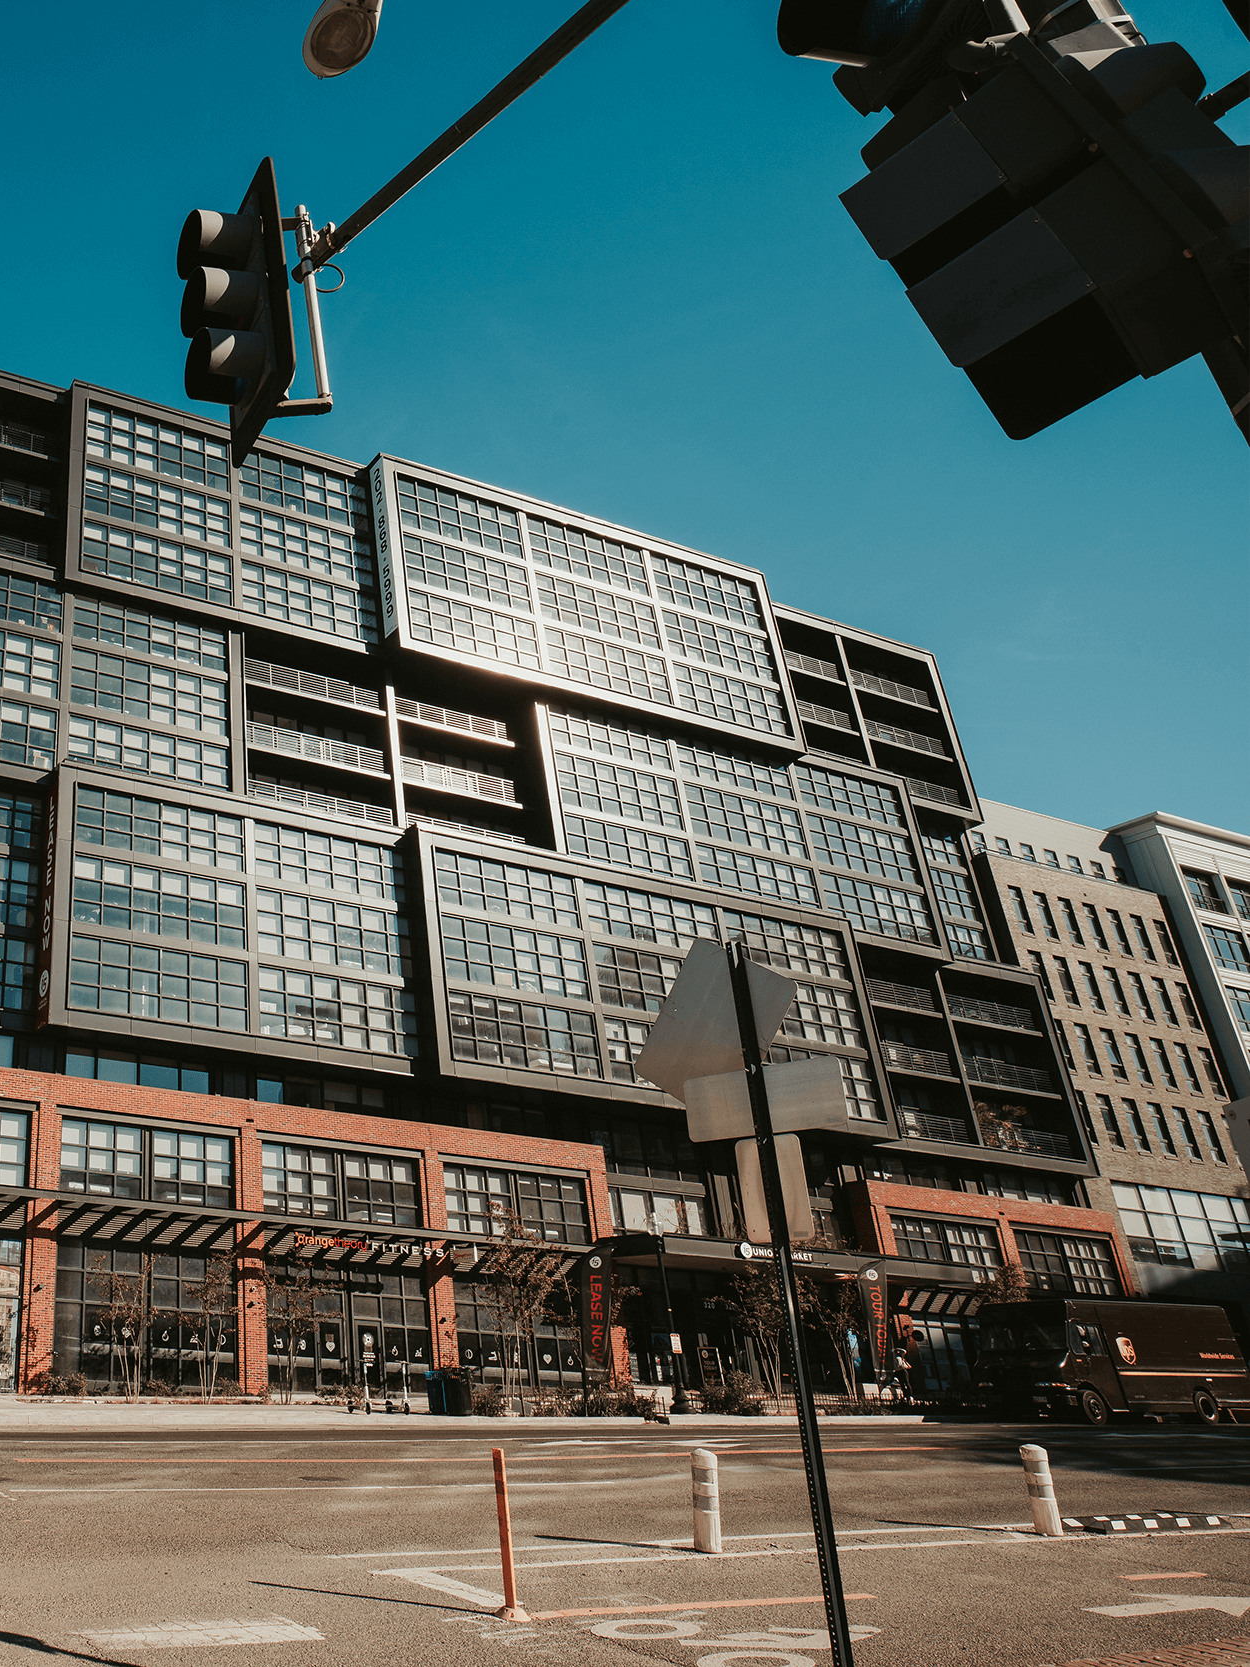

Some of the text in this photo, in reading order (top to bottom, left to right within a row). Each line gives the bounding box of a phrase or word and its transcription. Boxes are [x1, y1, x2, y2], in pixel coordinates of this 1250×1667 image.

[42, 796, 55, 951] LEASE NOW
[371, 1242, 444, 1257] FITNESS
[753, 1247, 774, 1258] UNIO
[703, 1301, 715, 1309] 320
[869, 1285, 885, 1320] TOUR
[590, 1275, 603, 1362] LEASE NOW
